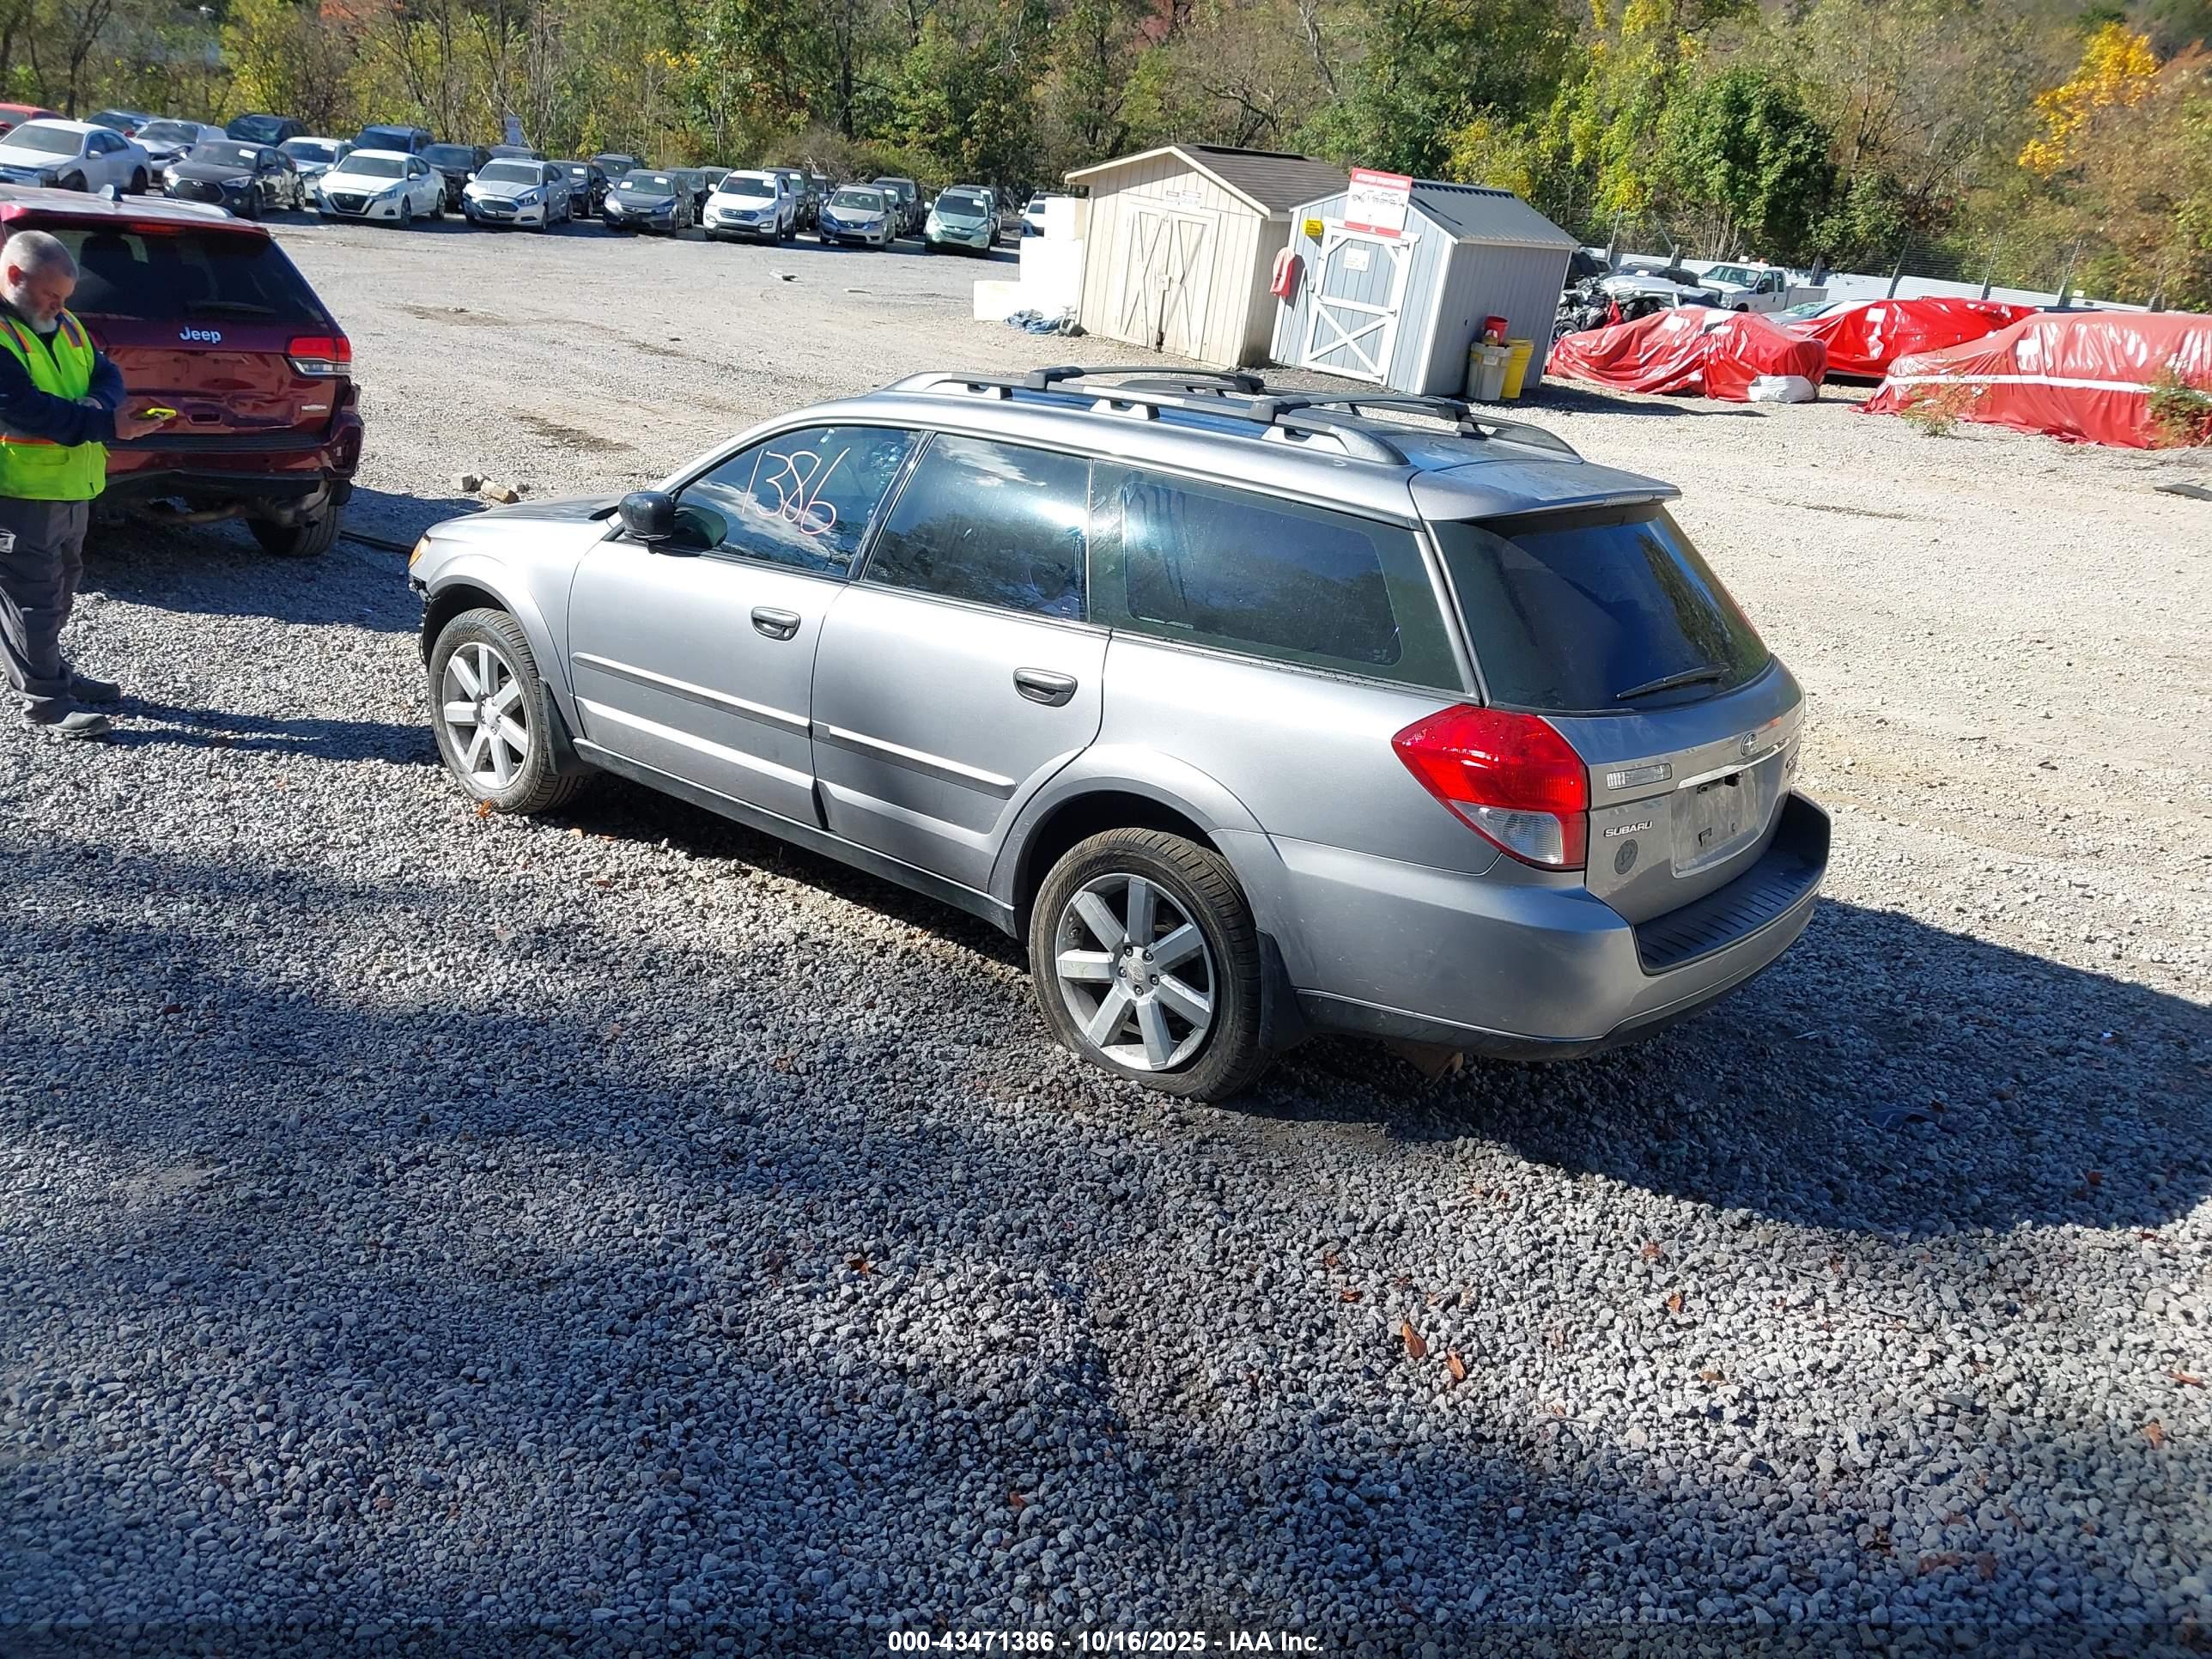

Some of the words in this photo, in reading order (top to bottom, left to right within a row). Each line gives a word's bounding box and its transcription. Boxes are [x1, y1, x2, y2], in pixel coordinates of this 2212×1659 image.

[179, 325, 222, 344] Jeep
[741, 447, 851, 535] 1386
[1604, 820, 1654, 838] SUBARU
